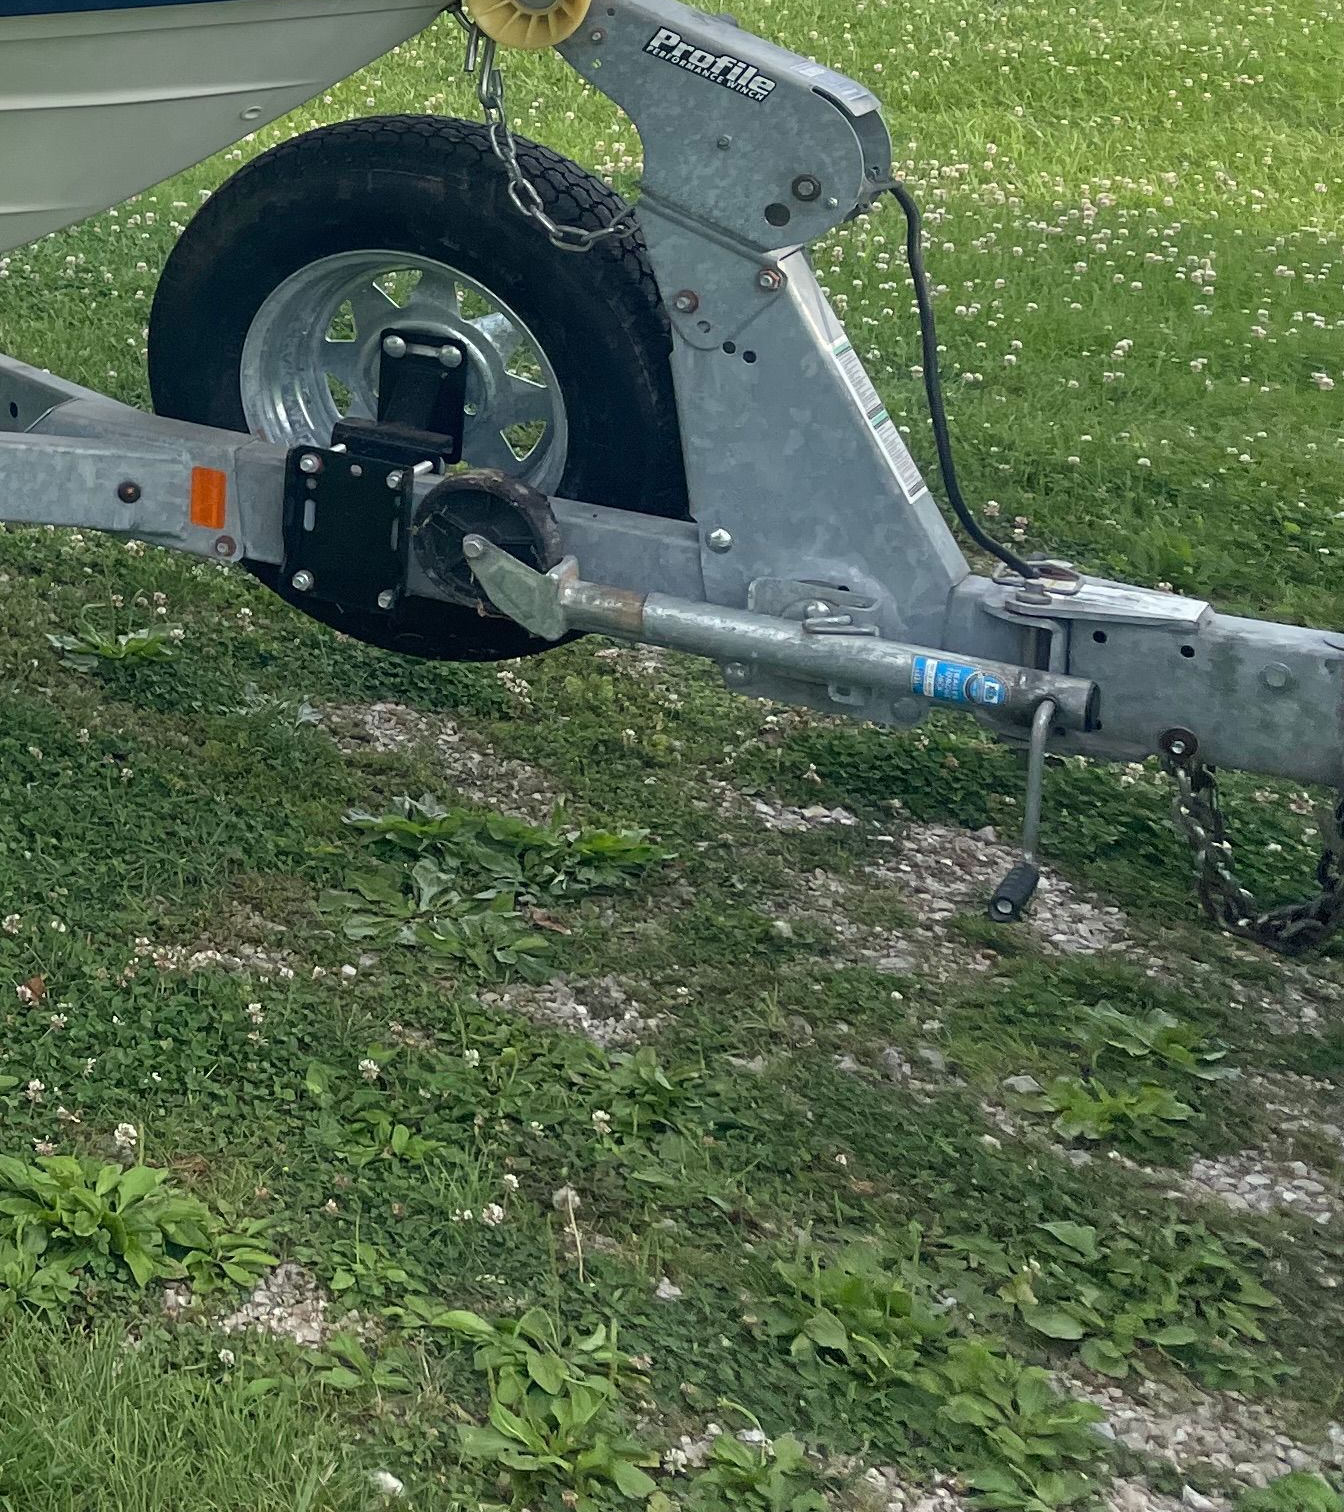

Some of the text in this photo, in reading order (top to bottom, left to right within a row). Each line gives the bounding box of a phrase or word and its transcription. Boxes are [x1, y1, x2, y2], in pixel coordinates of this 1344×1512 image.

[645, 45, 724, 84] PERFORMANCE
[725, 79, 765, 101] WINCH
[649, 27, 777, 95] Profile
